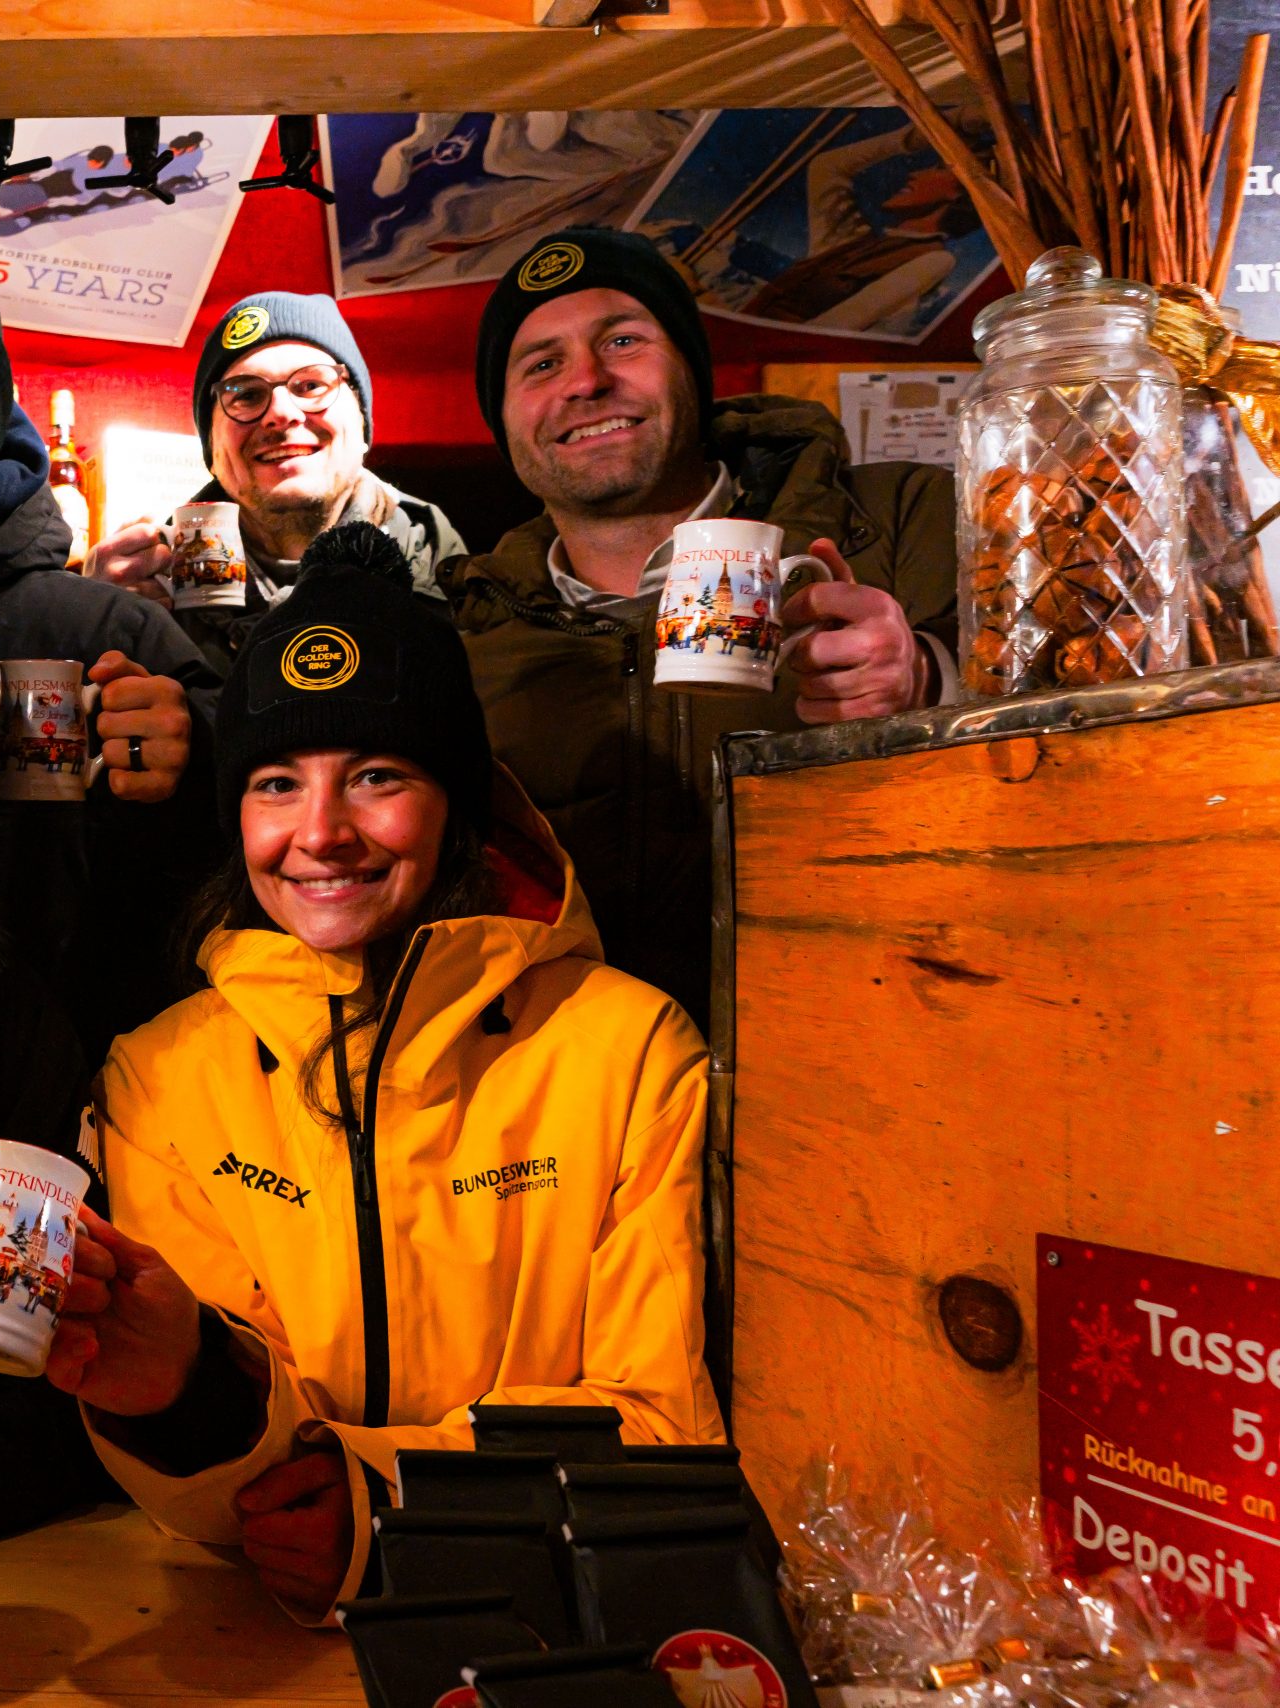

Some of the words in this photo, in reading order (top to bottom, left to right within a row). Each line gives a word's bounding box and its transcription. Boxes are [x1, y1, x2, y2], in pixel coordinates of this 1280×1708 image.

[52, 256, 131, 275] BOBSLEIGH
[136, 268, 172, 280] CLUB
[24, 265, 169, 307] YEARS
[297, 652, 342, 663] GOLDENE
[311, 644, 329, 653] DER
[308, 661, 331, 671] RING
[452, 1156, 558, 1195] BUNDESWEHR
[53, 1230, 68, 1248] 125
[1084, 1434, 1228, 1504] Rücknahme
[1073, 1496, 1254, 1607] Deposit
